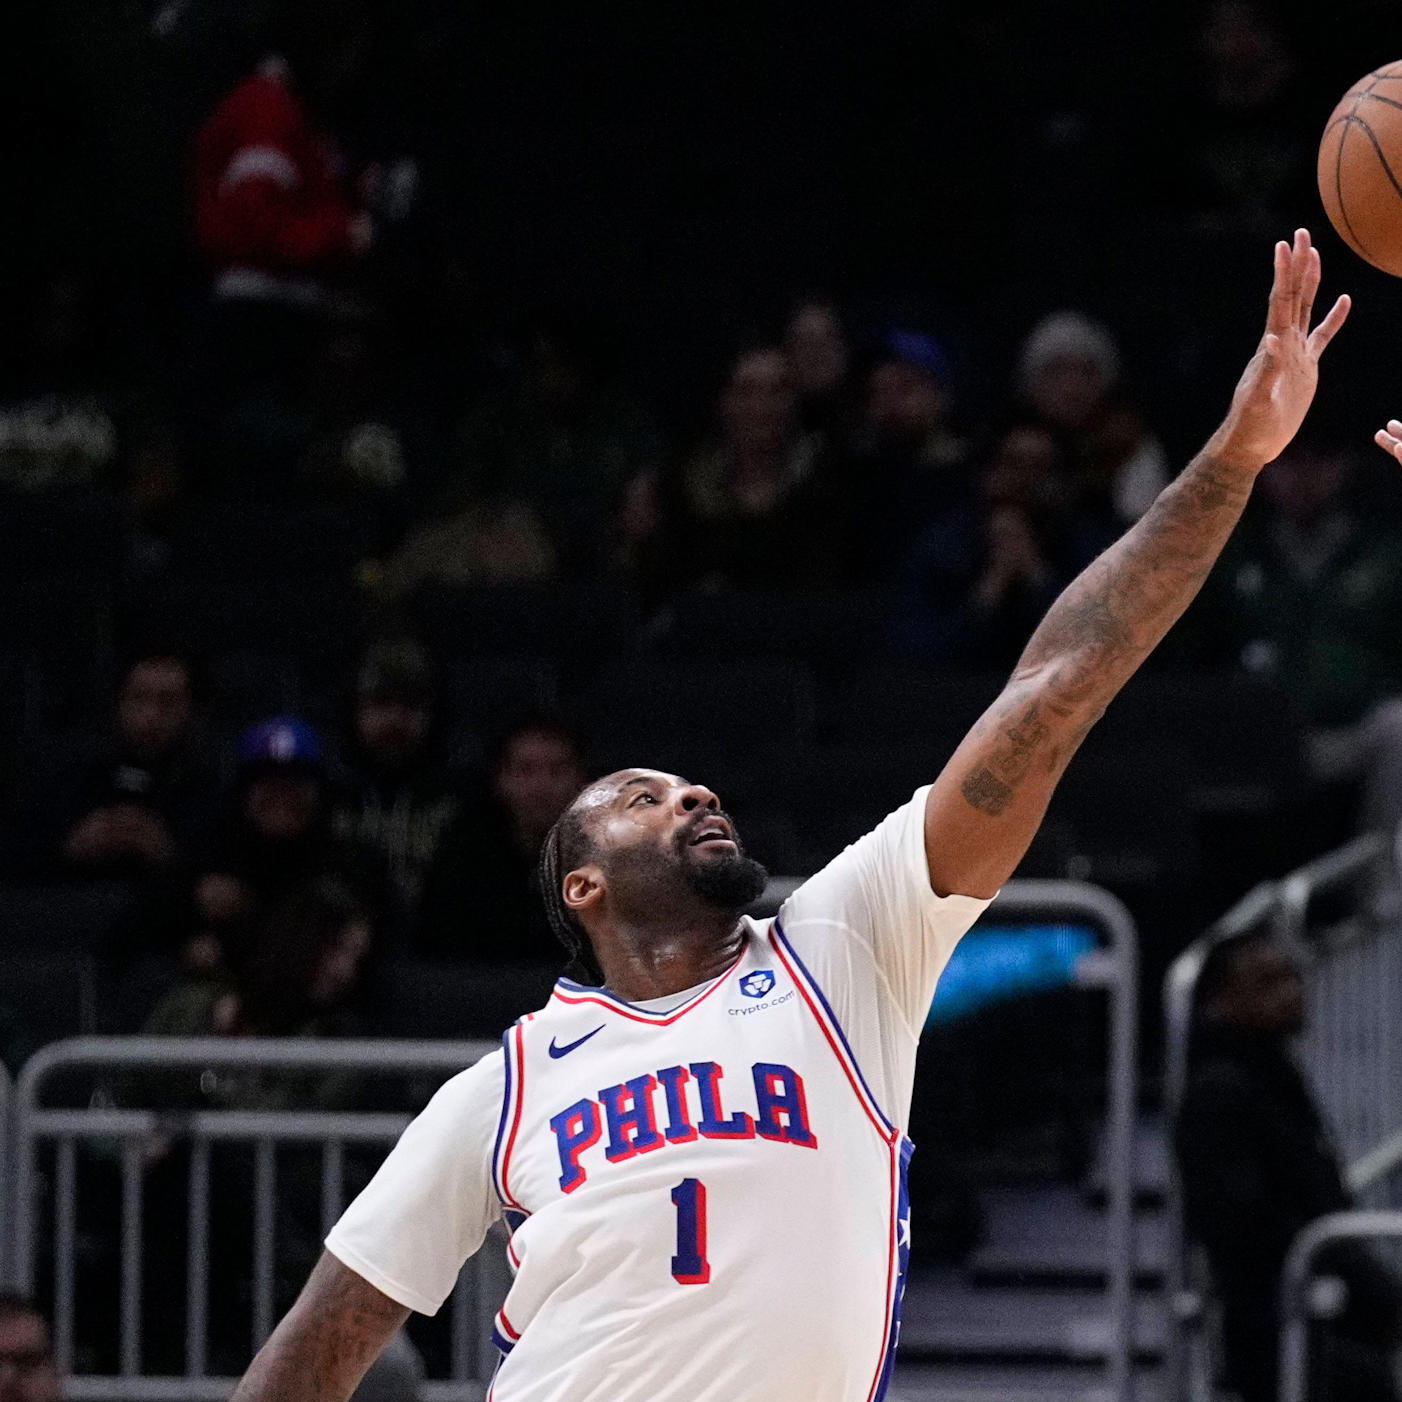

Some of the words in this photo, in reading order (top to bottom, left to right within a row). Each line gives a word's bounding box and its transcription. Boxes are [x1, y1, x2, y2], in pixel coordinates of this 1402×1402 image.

[728, 989, 797, 1017] crypto.com
[549, 1060, 818, 1195] PHILA
[670, 1177, 711, 1285] 1
